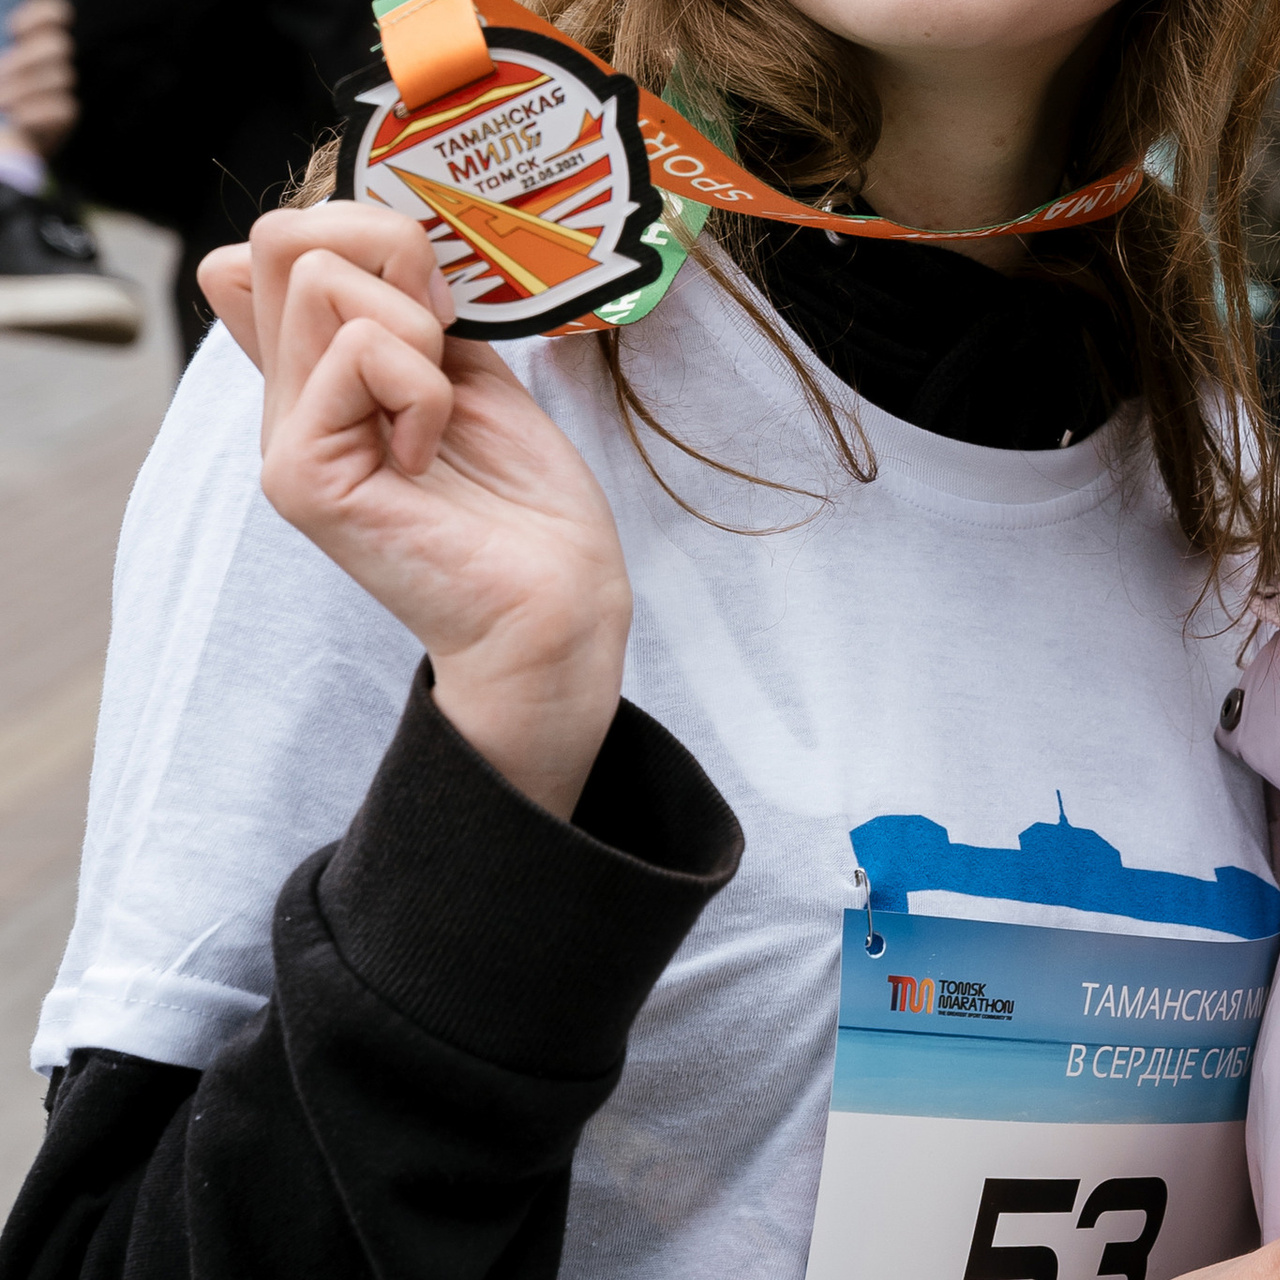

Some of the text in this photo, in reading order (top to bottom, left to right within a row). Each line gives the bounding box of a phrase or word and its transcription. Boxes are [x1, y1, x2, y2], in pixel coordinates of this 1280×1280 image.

[433, 86, 565, 158] ТАМАНСКАЯ
[446, 121, 542, 184] МИЛЯ
[473, 156, 541, 194] ТОМСК
[938, 979, 986, 998] TOMSK
[938, 994, 1015, 1015] MARATHON
[1081, 981, 1244, 1021] ТАМАНСКАЯ
[1065, 1044, 1087, 1077] В
[1092, 1045, 1199, 1087] СЕРДЦЕ
